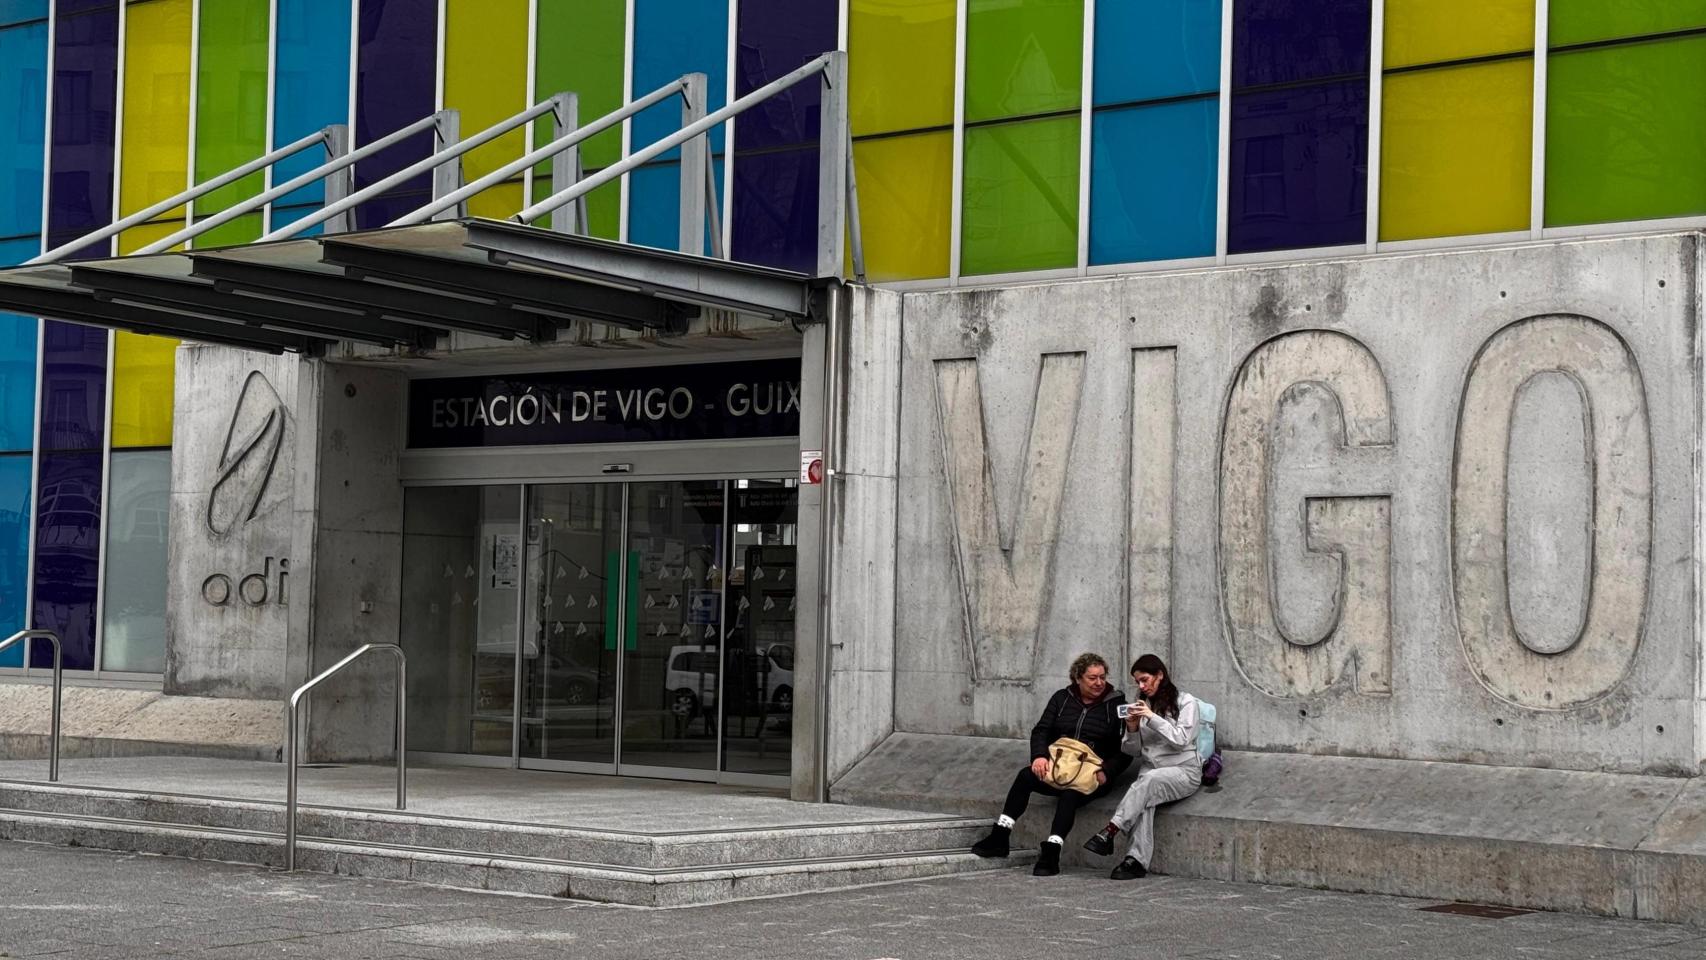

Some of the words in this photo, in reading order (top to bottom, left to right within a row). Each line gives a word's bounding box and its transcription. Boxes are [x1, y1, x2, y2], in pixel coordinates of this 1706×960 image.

[432, 386, 562, 428] ESTACIÓN
[572, 390, 607, 422] DE
[616, 386, 693, 421] VIGO
[932, 314, 1653, 711] VIGO
